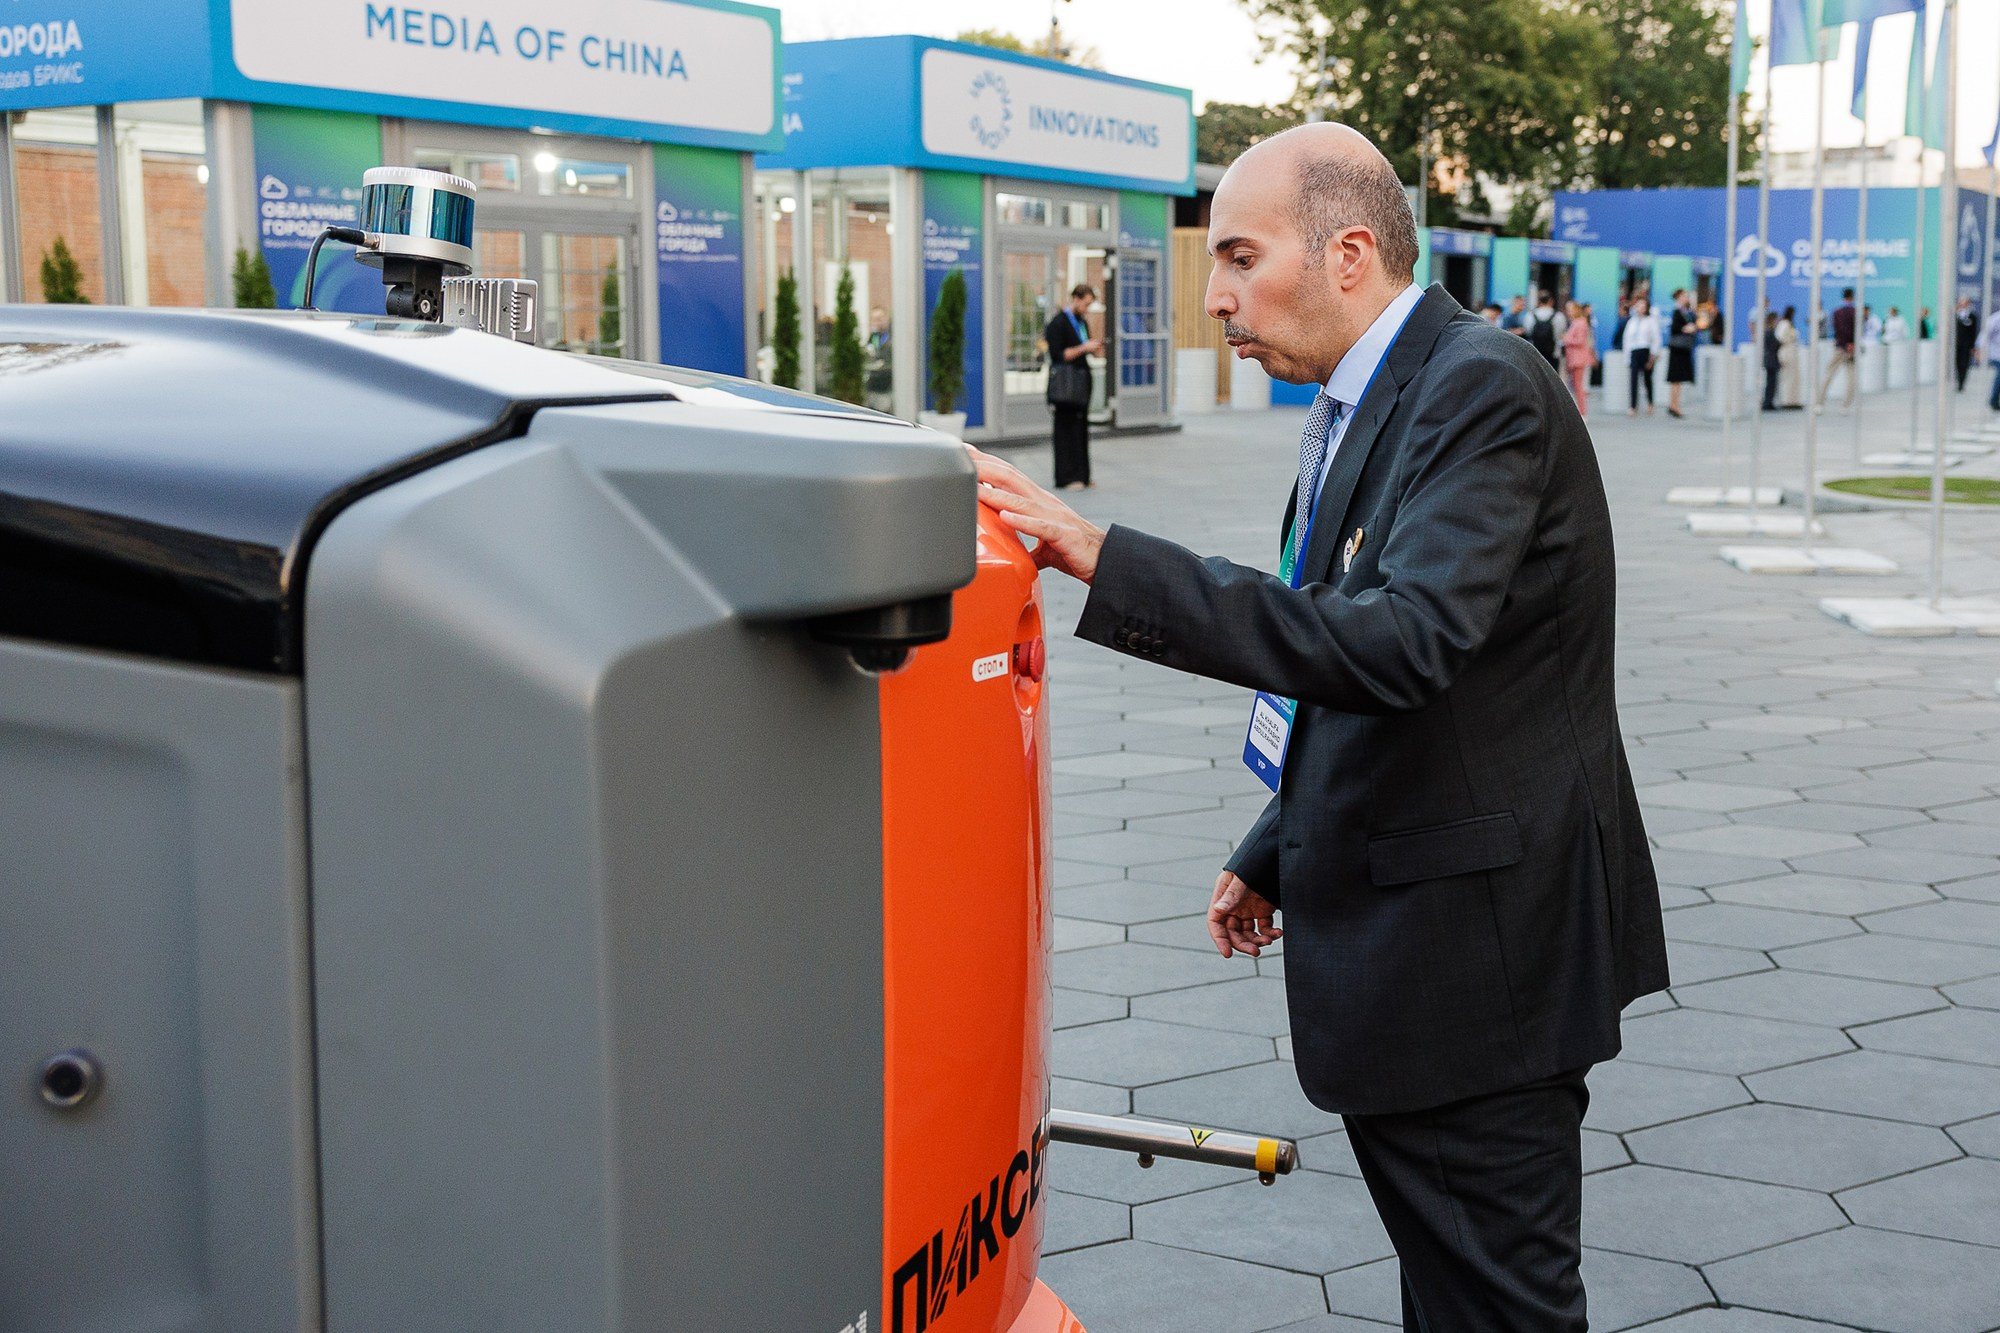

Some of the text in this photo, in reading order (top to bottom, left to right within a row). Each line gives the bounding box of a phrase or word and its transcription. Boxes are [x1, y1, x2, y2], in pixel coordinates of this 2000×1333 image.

[366, 4, 688, 80] MEDIA OF CHINA
[33, 61, 84, 86] БРИКС
[1029, 104, 1160, 148] INNOVATIONS
[891, 1115, 1047, 1333] ПИКСЕ
